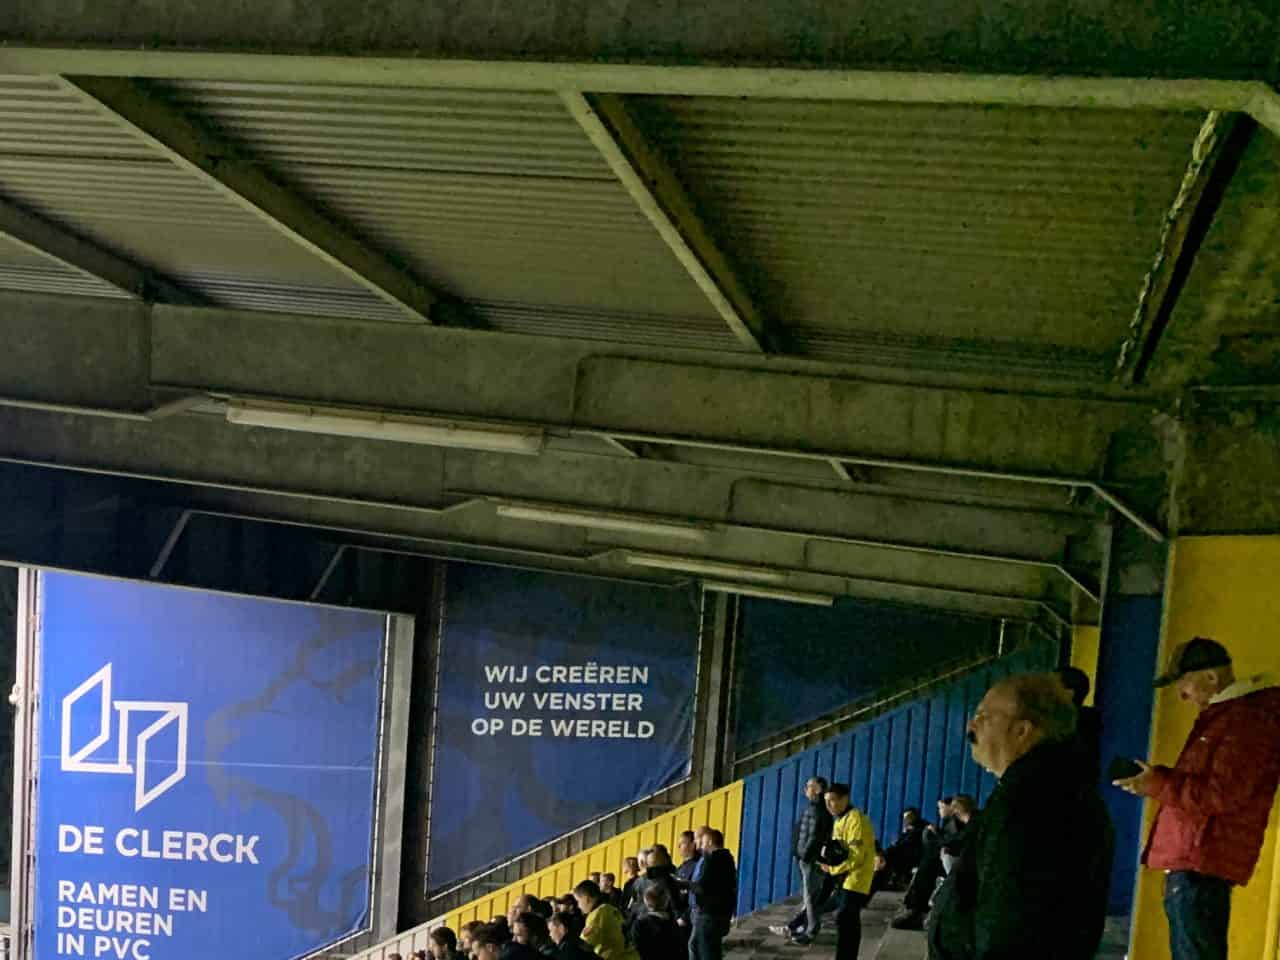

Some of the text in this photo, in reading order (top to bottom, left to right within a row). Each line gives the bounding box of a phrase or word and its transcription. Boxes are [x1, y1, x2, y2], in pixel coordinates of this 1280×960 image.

[484, 661, 649, 684] WIJ CREËREN
[484, 692, 643, 711] UW VENSTER
[471, 718, 655, 738] OP DE WERELD
[58, 824, 260, 865] DE CLERCK
[58, 880, 208, 912] RAMEN EN
[57, 906, 173, 937] DEUREN
[57, 932, 85, 956] IN
